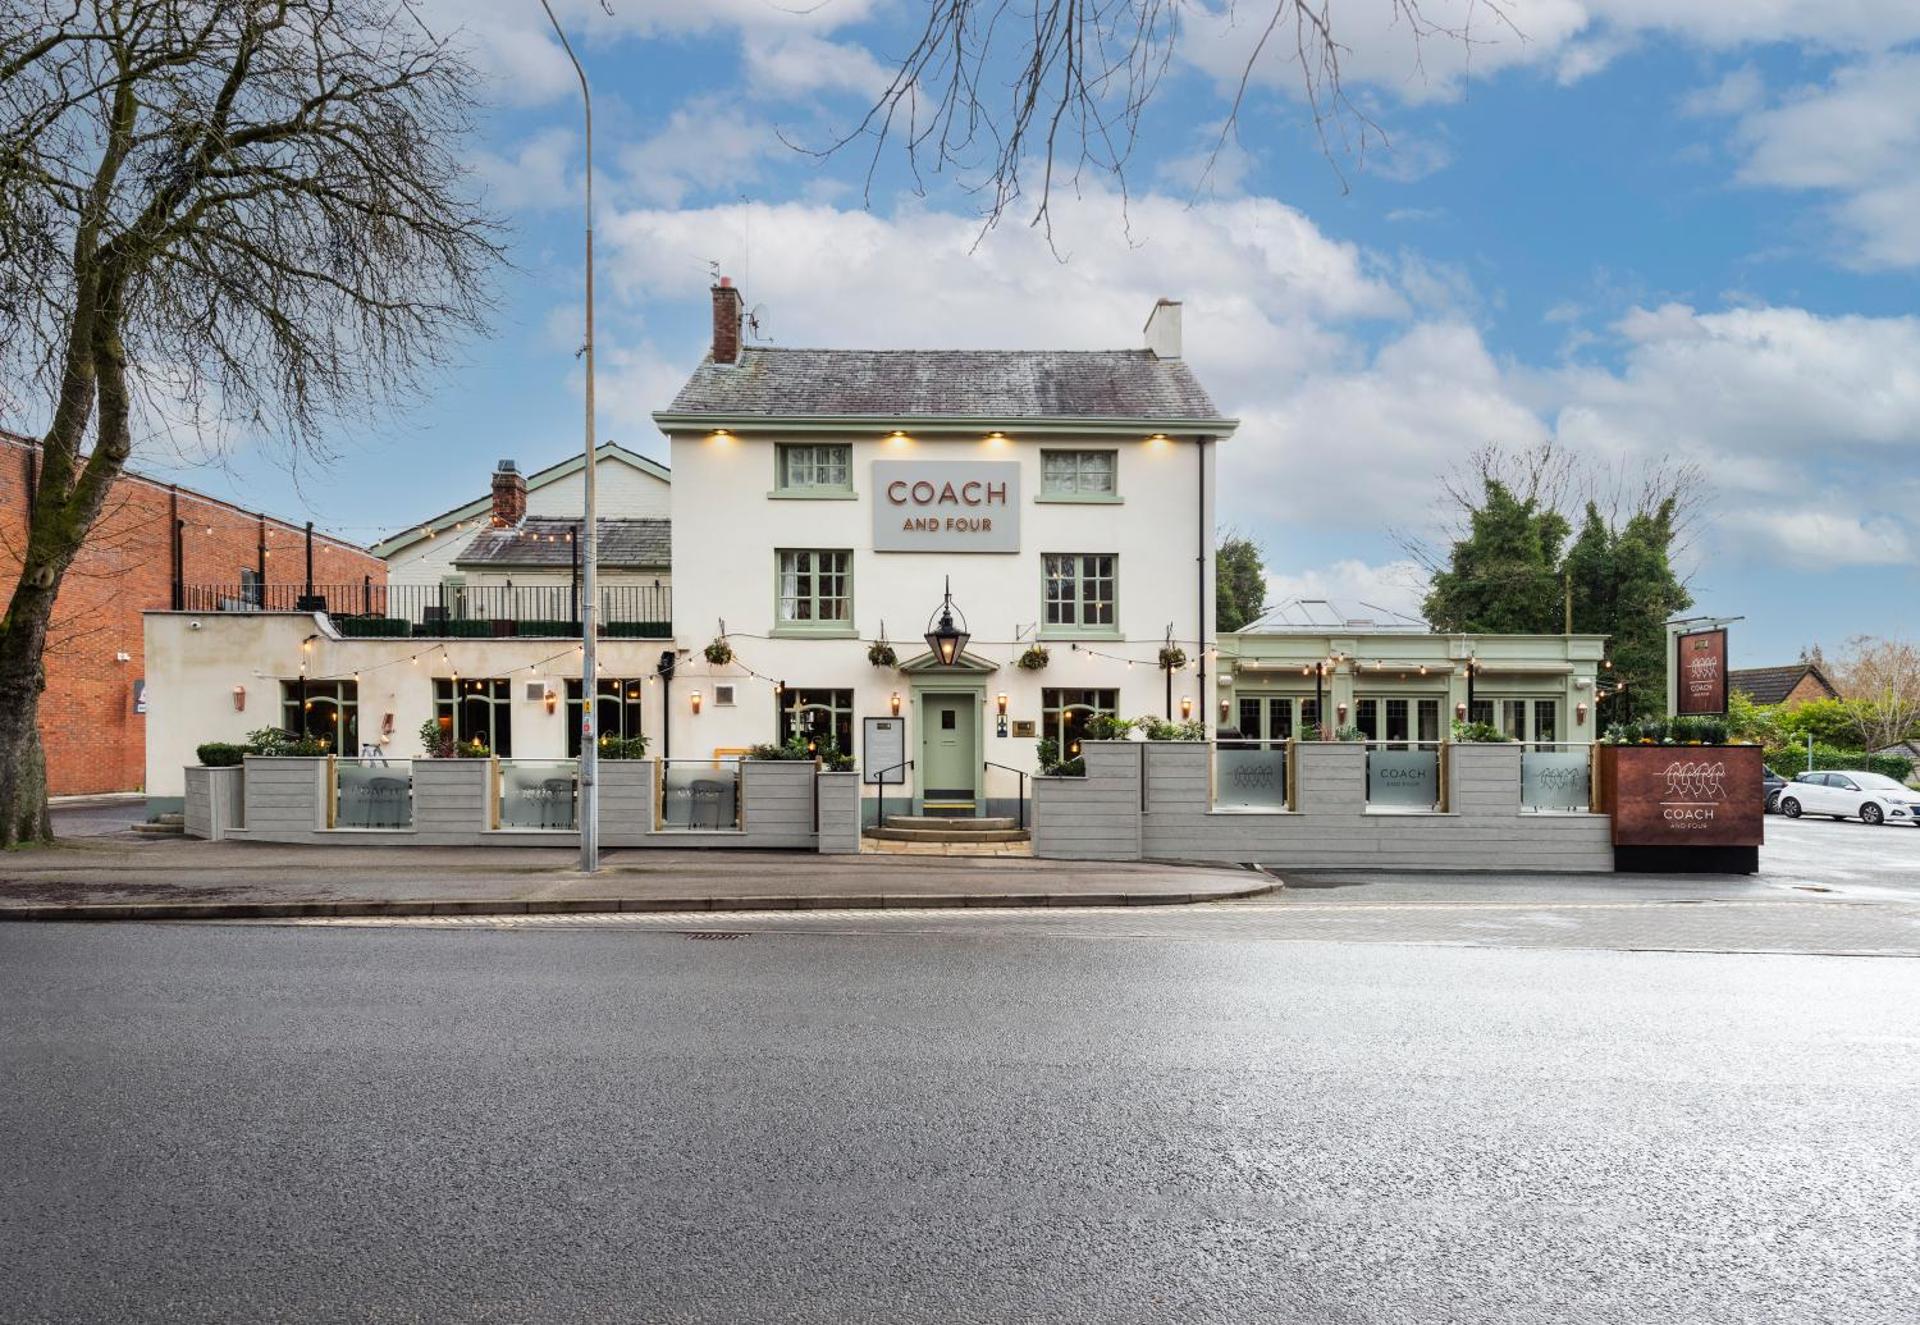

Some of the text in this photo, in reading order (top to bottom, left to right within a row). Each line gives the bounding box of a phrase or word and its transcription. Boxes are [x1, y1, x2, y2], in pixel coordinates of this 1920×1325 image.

[887, 481, 1006, 505] COACH
[903, 518, 992, 532] AND FOUR
[1380, 768, 1426, 779] COACH
[1663, 808, 1714, 820] COACH
